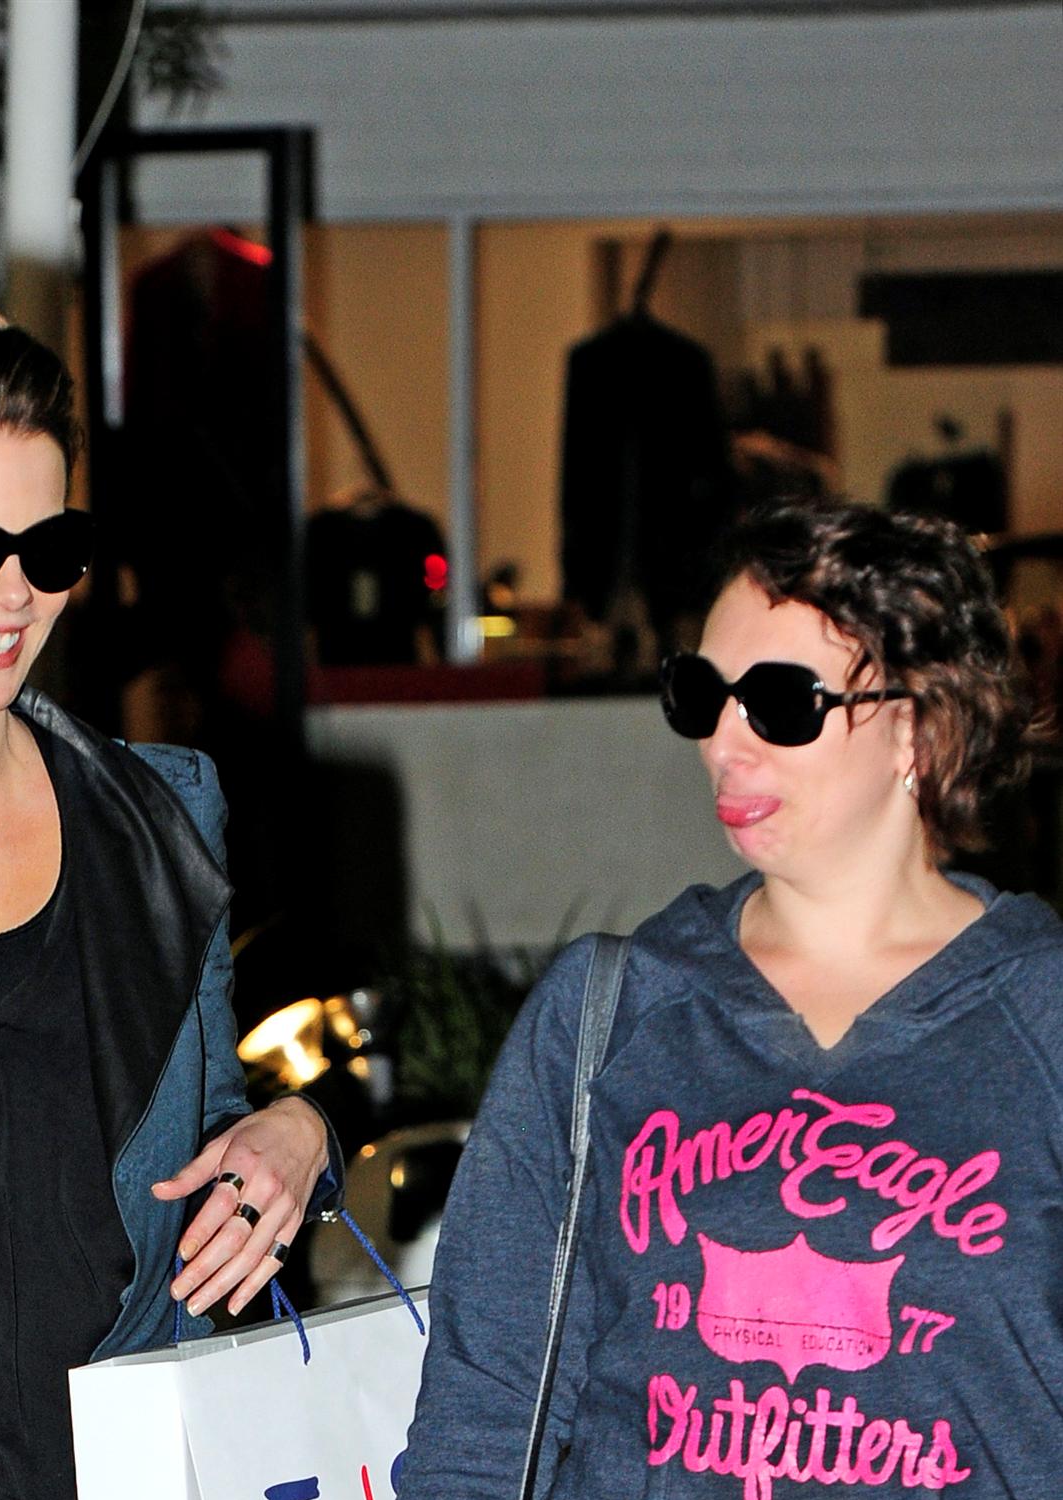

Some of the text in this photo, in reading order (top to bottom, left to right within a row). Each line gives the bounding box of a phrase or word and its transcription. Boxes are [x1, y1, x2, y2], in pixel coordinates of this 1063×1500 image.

[652, 1282, 956, 1354] 19 77
[713, 1325, 873, 1356] PHYSICAL EDUCATION
